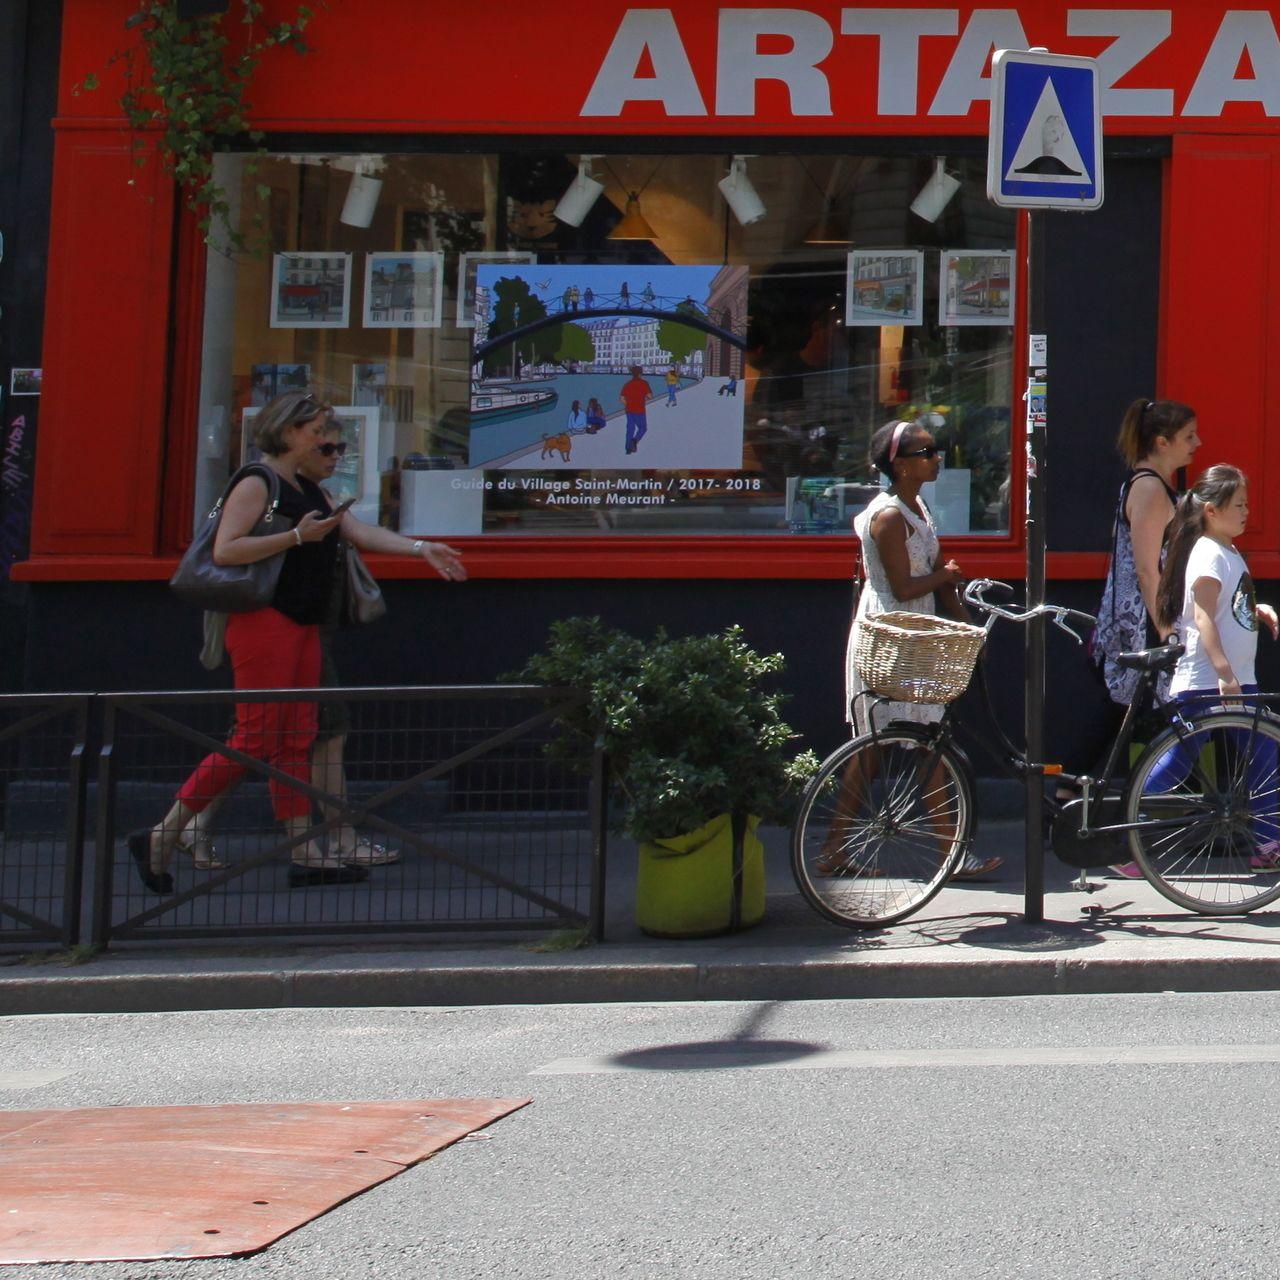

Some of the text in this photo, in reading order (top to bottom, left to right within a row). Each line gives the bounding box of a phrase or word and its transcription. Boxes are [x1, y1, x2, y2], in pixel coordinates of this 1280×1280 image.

[450, 478, 493, 490] Guide
[498, 478, 516, 490] du
[521, 478, 571, 493] Village
[575, 477, 662, 490] Saint-Martin
[725, 478, 761, 490] 2018
[546, 494, 601, 505] Antoine
[605, 494, 666, 505] Meurant
